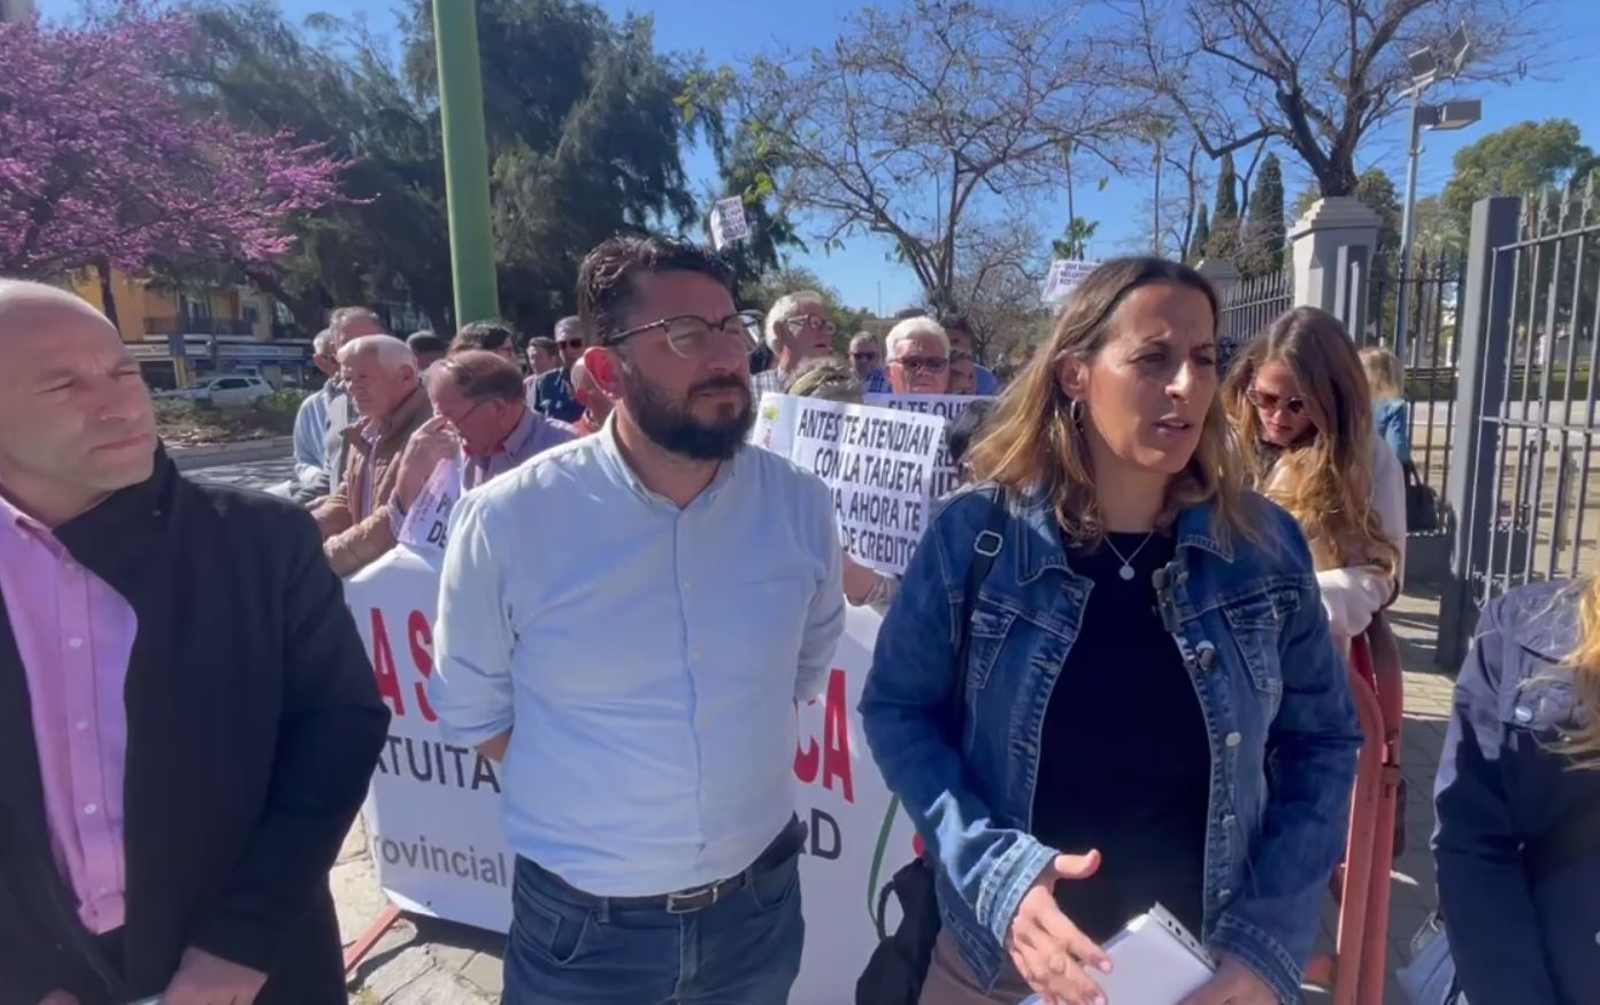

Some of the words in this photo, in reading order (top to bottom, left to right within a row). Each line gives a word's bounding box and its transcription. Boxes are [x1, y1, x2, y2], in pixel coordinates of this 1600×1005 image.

[797, 409, 842, 442] ANTES
[843, 415, 860, 445] TE
[858, 416, 934, 456] ATENDÍAN
[814, 447, 844, 479] CON
[843, 453, 860, 484] LA
[864, 456, 922, 495] TARJETA
[849, 491, 899, 530] AHORA
[904, 500, 921, 533] TE
[842, 525, 856, 555] DE
[379, 734, 501, 793] TUITA
